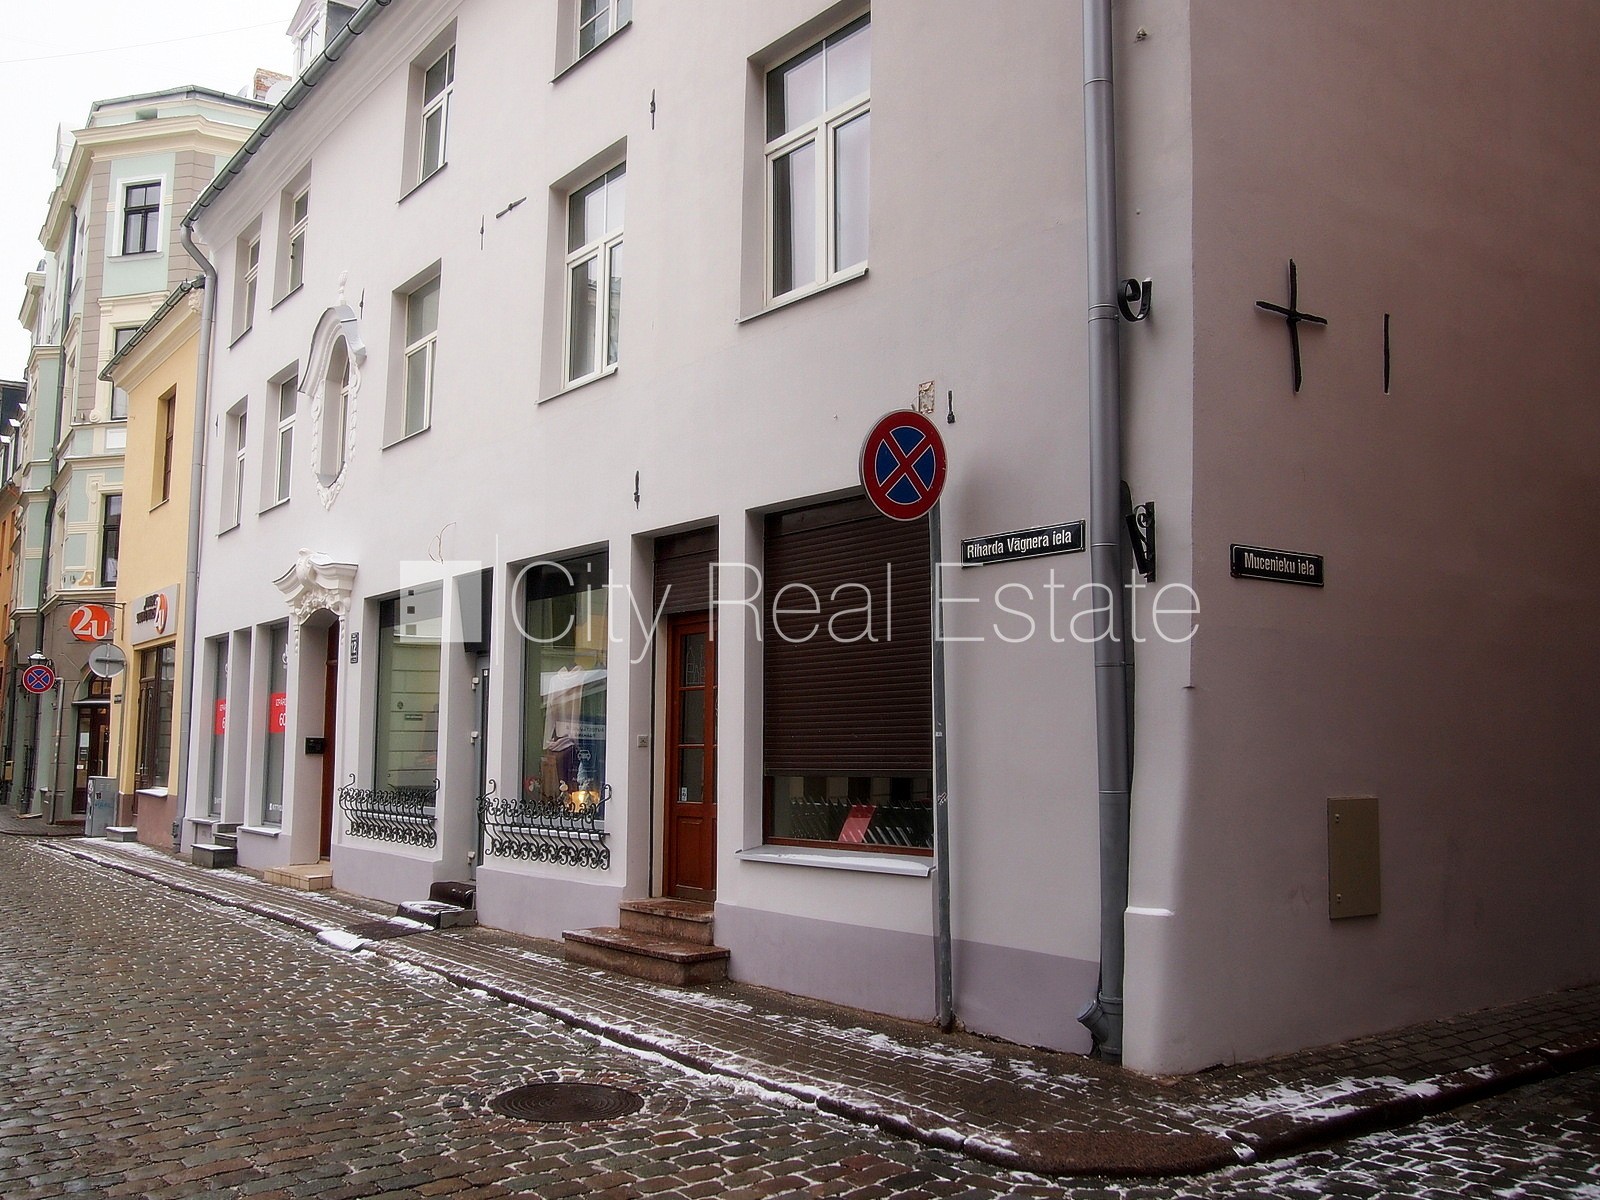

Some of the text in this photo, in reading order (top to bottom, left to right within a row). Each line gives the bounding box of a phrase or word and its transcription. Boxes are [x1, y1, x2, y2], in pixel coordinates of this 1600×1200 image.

[966, 529, 1072, 559] Riharda Vāgnera iela
[1244, 552, 1315, 576] Mucenieku iela
